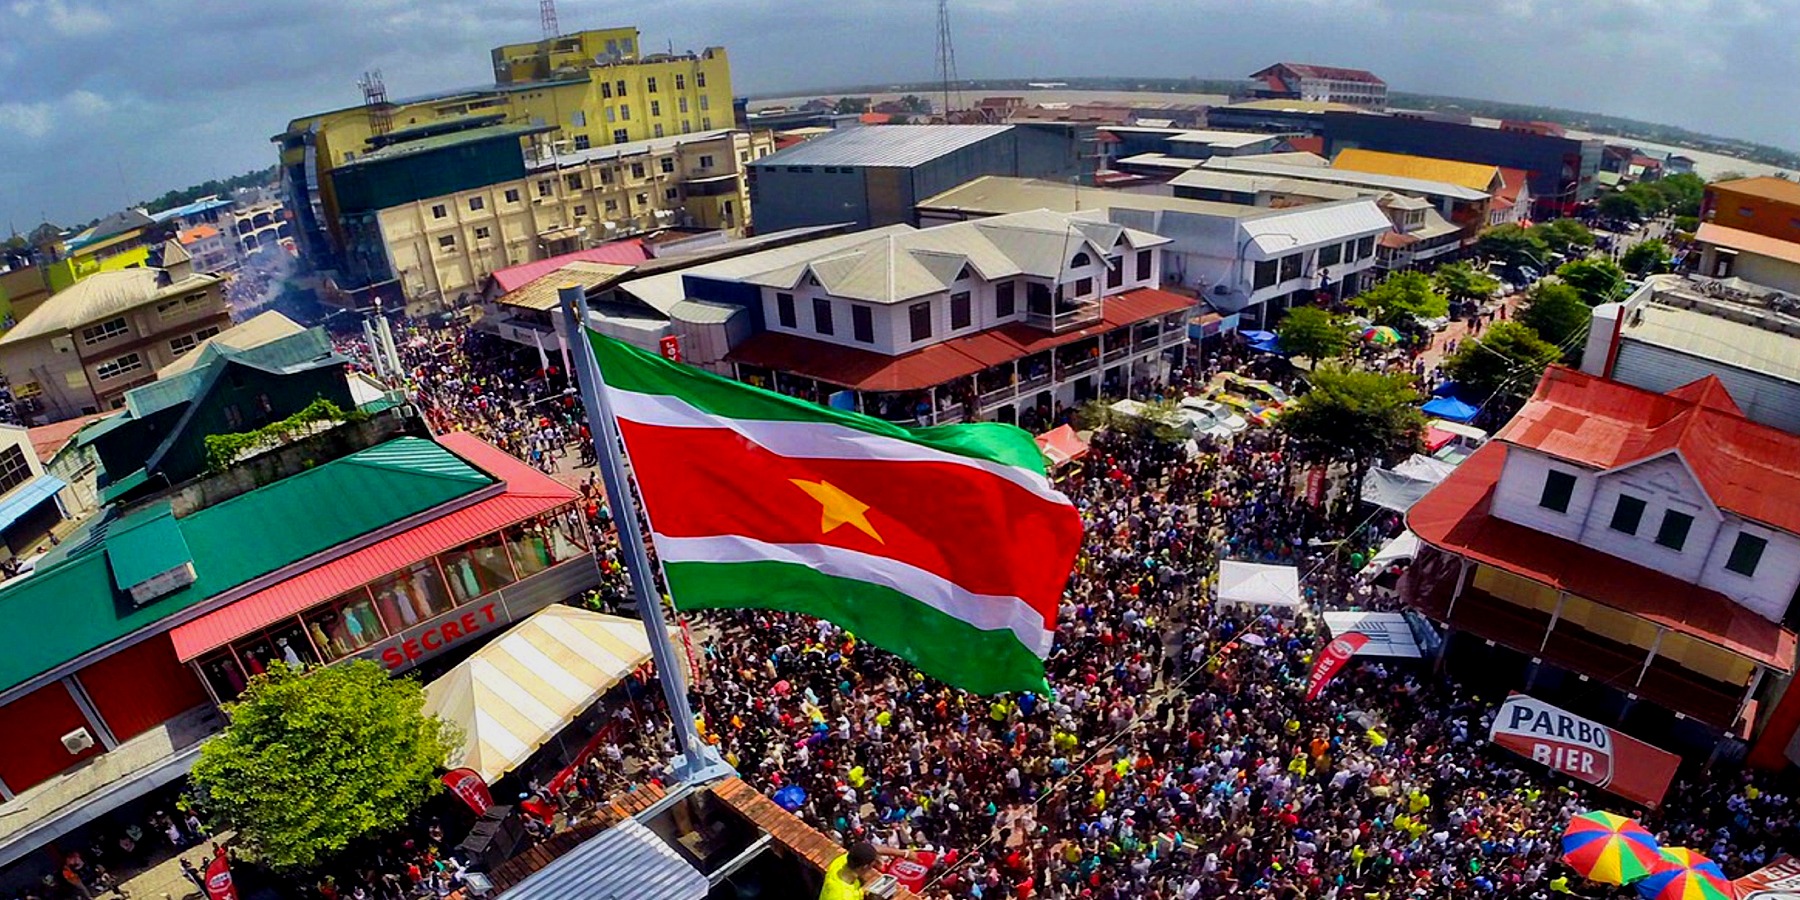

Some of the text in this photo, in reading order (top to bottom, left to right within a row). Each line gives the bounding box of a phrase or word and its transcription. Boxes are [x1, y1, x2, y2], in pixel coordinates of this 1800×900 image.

[382, 602, 496, 669] SECRET
[1508, 705, 1606, 749] PARBO
[1532, 743, 1594, 774] BIER
